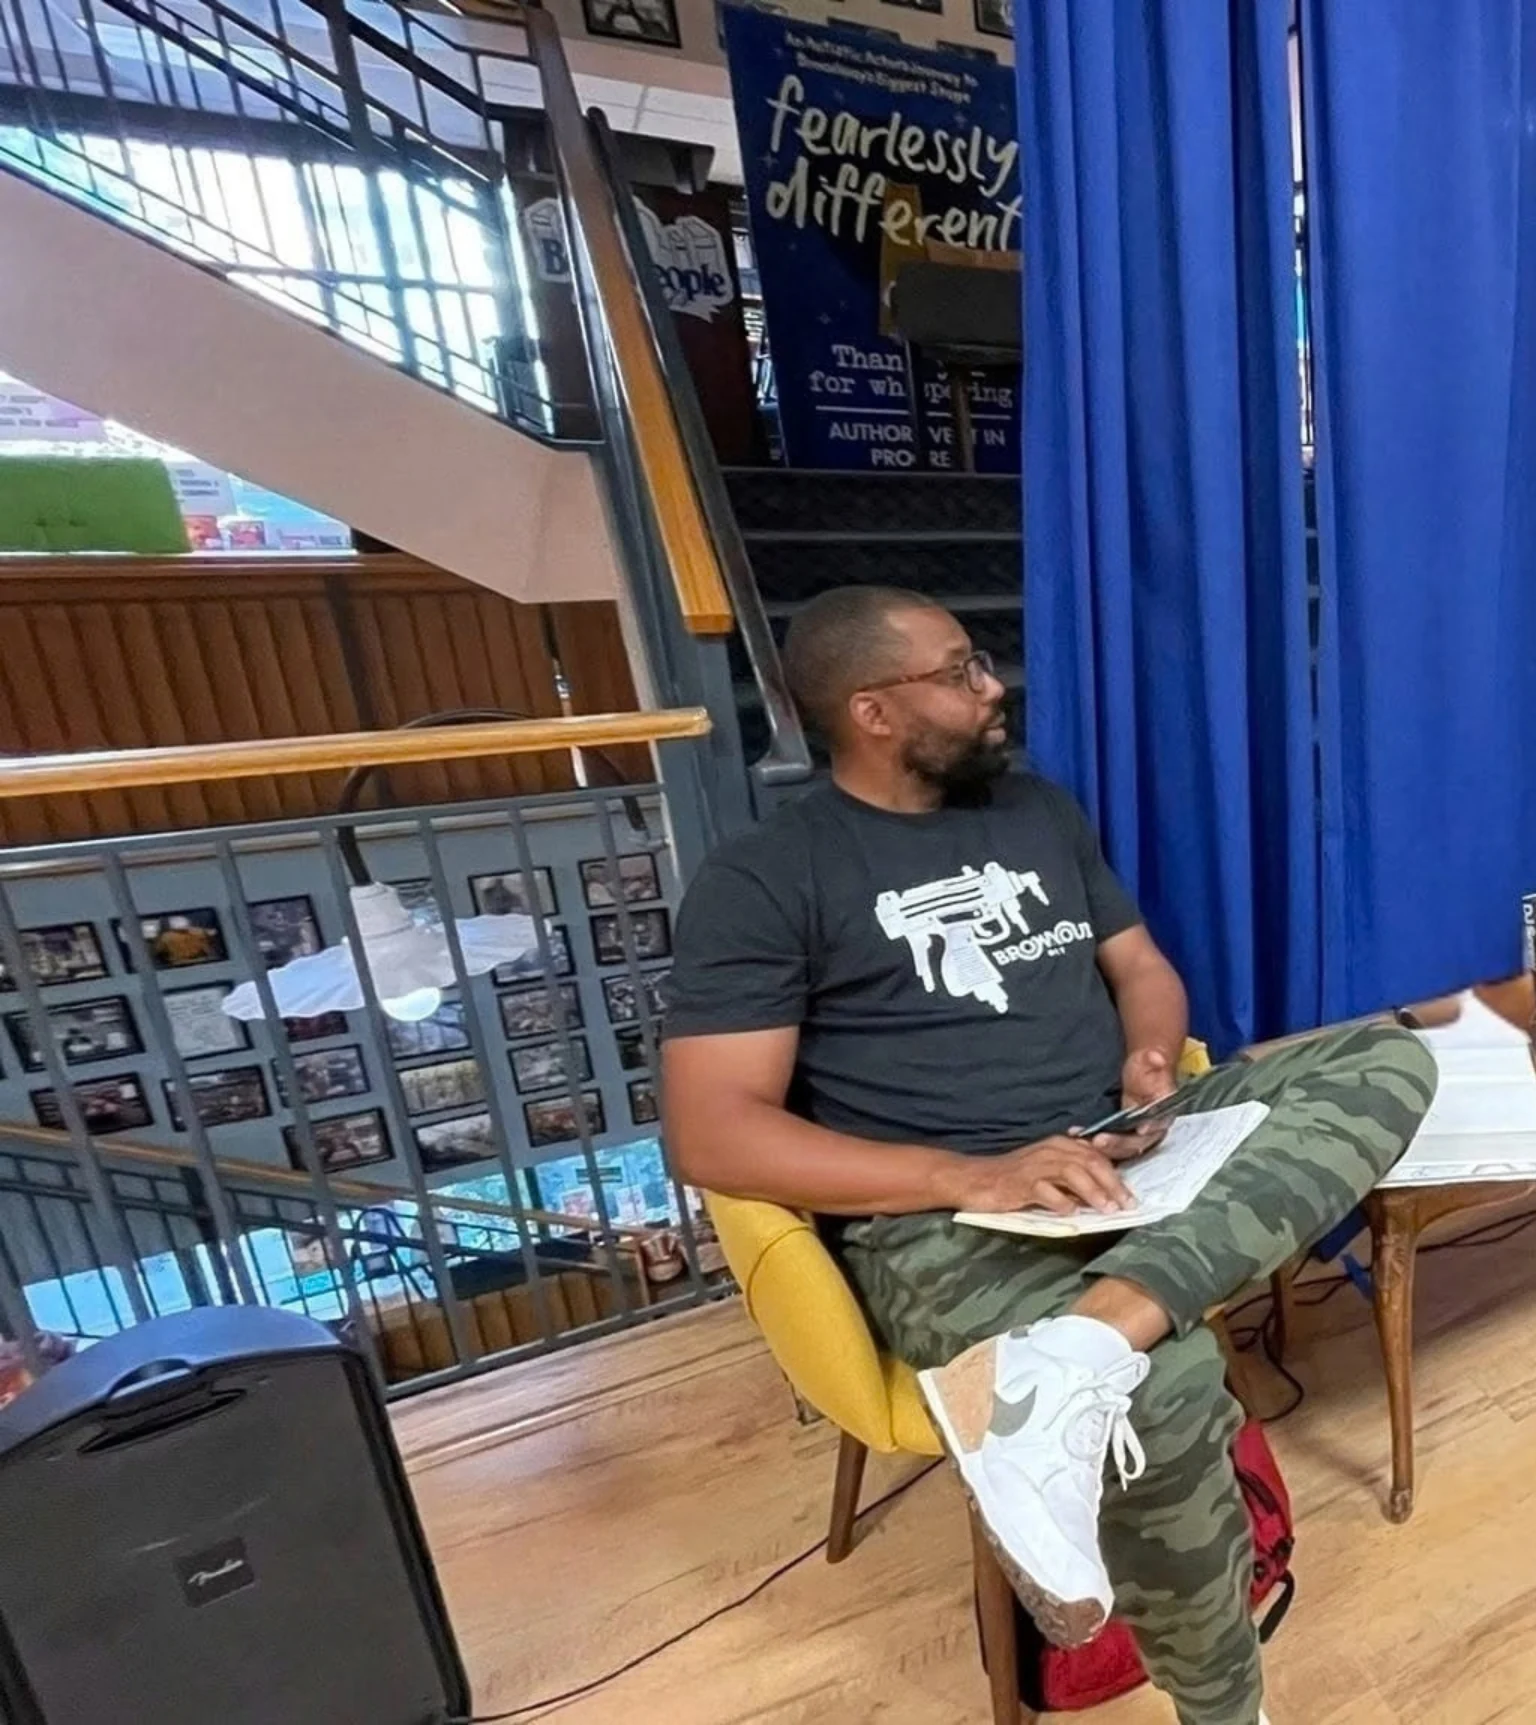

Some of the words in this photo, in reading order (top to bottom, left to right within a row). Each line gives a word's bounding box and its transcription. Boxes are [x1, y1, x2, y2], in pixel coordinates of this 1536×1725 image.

[766, 74, 1020, 197] fearlessly
[766, 156, 1023, 252] different
[832, 344, 905, 372] Than
[809, 370, 856, 394] for
[829, 422, 914, 443] AUTHOR
[984, 430, 1006, 445] IN
